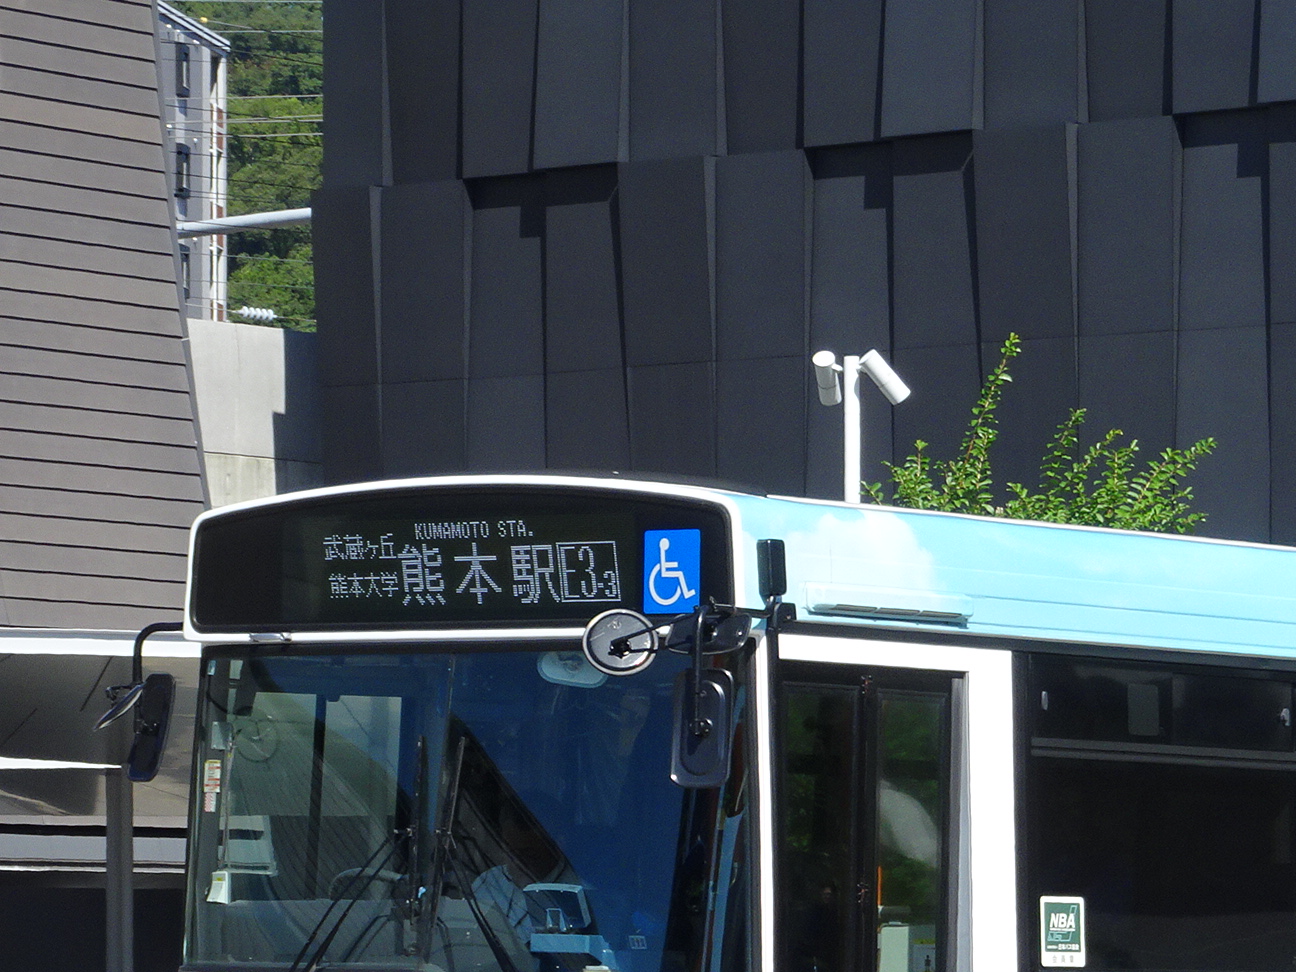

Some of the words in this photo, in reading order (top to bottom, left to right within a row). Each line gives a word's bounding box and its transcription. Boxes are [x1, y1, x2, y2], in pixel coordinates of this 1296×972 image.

[414, 521, 490, 540] KUMAMOTO
[497, 519, 534, 537] STA.
[328, 572, 399, 599] 熊本大学
[397, 541, 560, 606] 熊本駅
[1049, 912, 1076, 928] NBA
